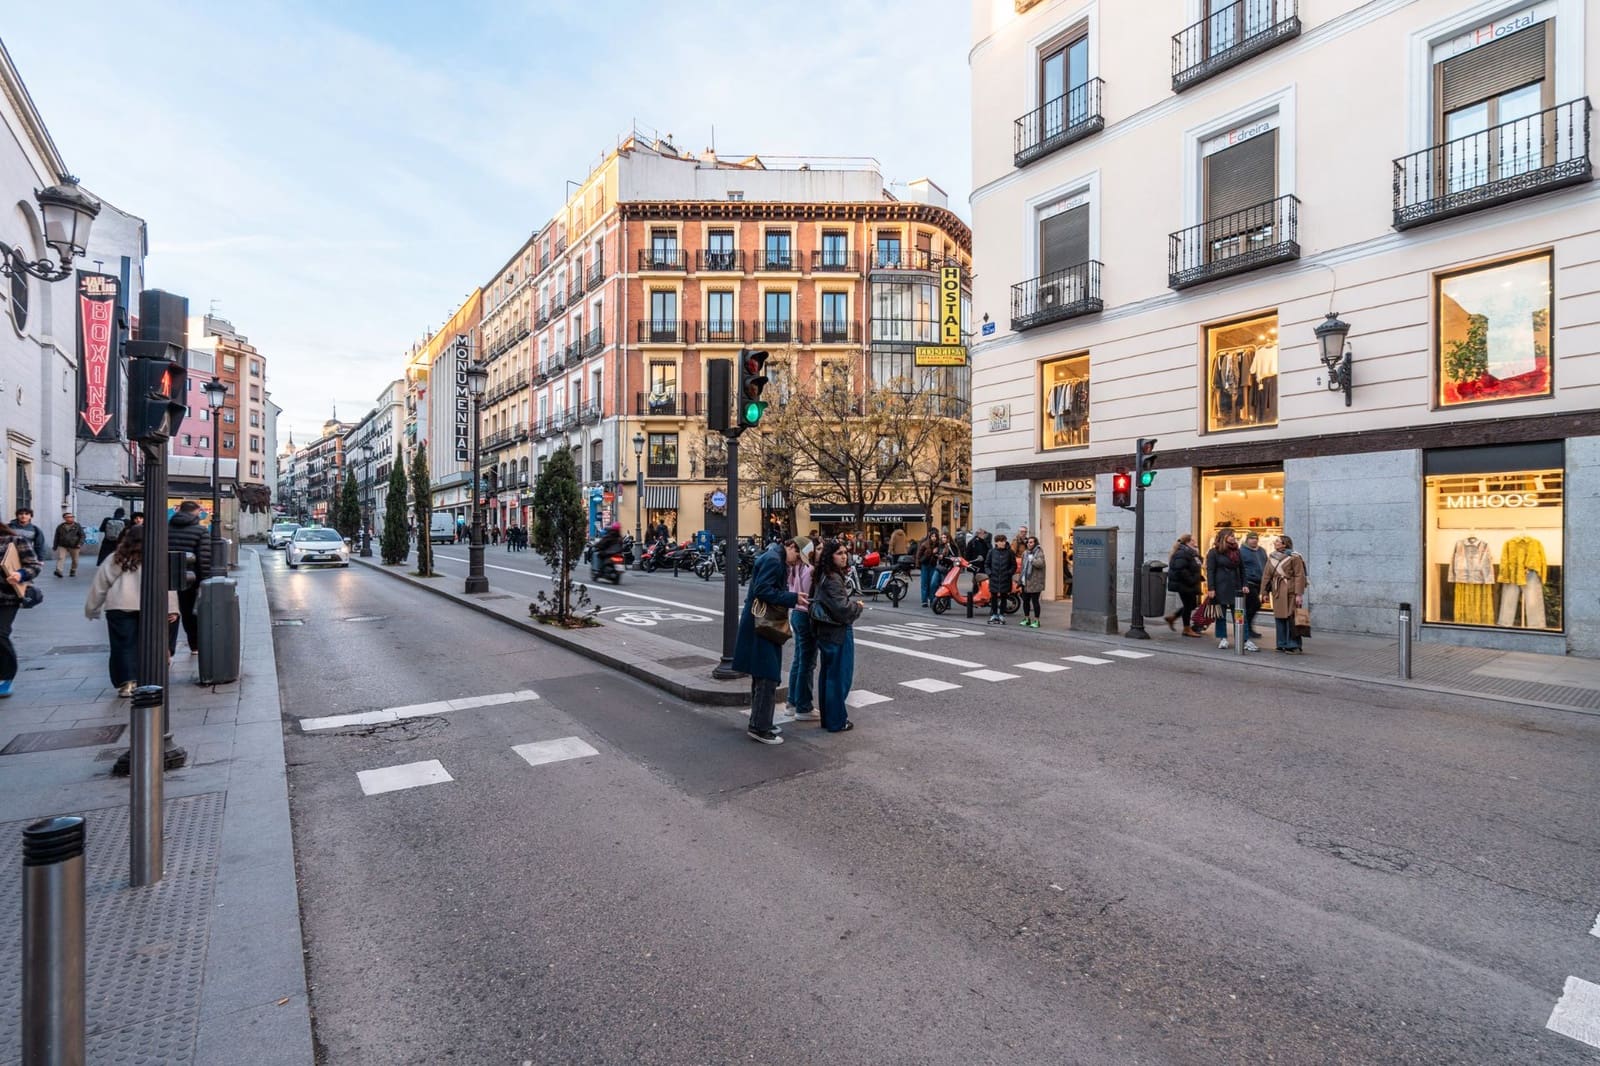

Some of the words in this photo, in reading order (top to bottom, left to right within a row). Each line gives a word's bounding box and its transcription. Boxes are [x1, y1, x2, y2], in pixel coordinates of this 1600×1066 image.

[1475, 10, 1535, 45] Hostal
[1228, 121, 1271, 145] Edreira
[944, 268, 958, 337] HOSTAL
[90, 301, 109, 425] BOXING
[456, 335, 468, 461] MONUMENTAL
[1042, 479, 1092, 492] MIHOOS
[1446, 493, 1539, 508] MIHOOS
